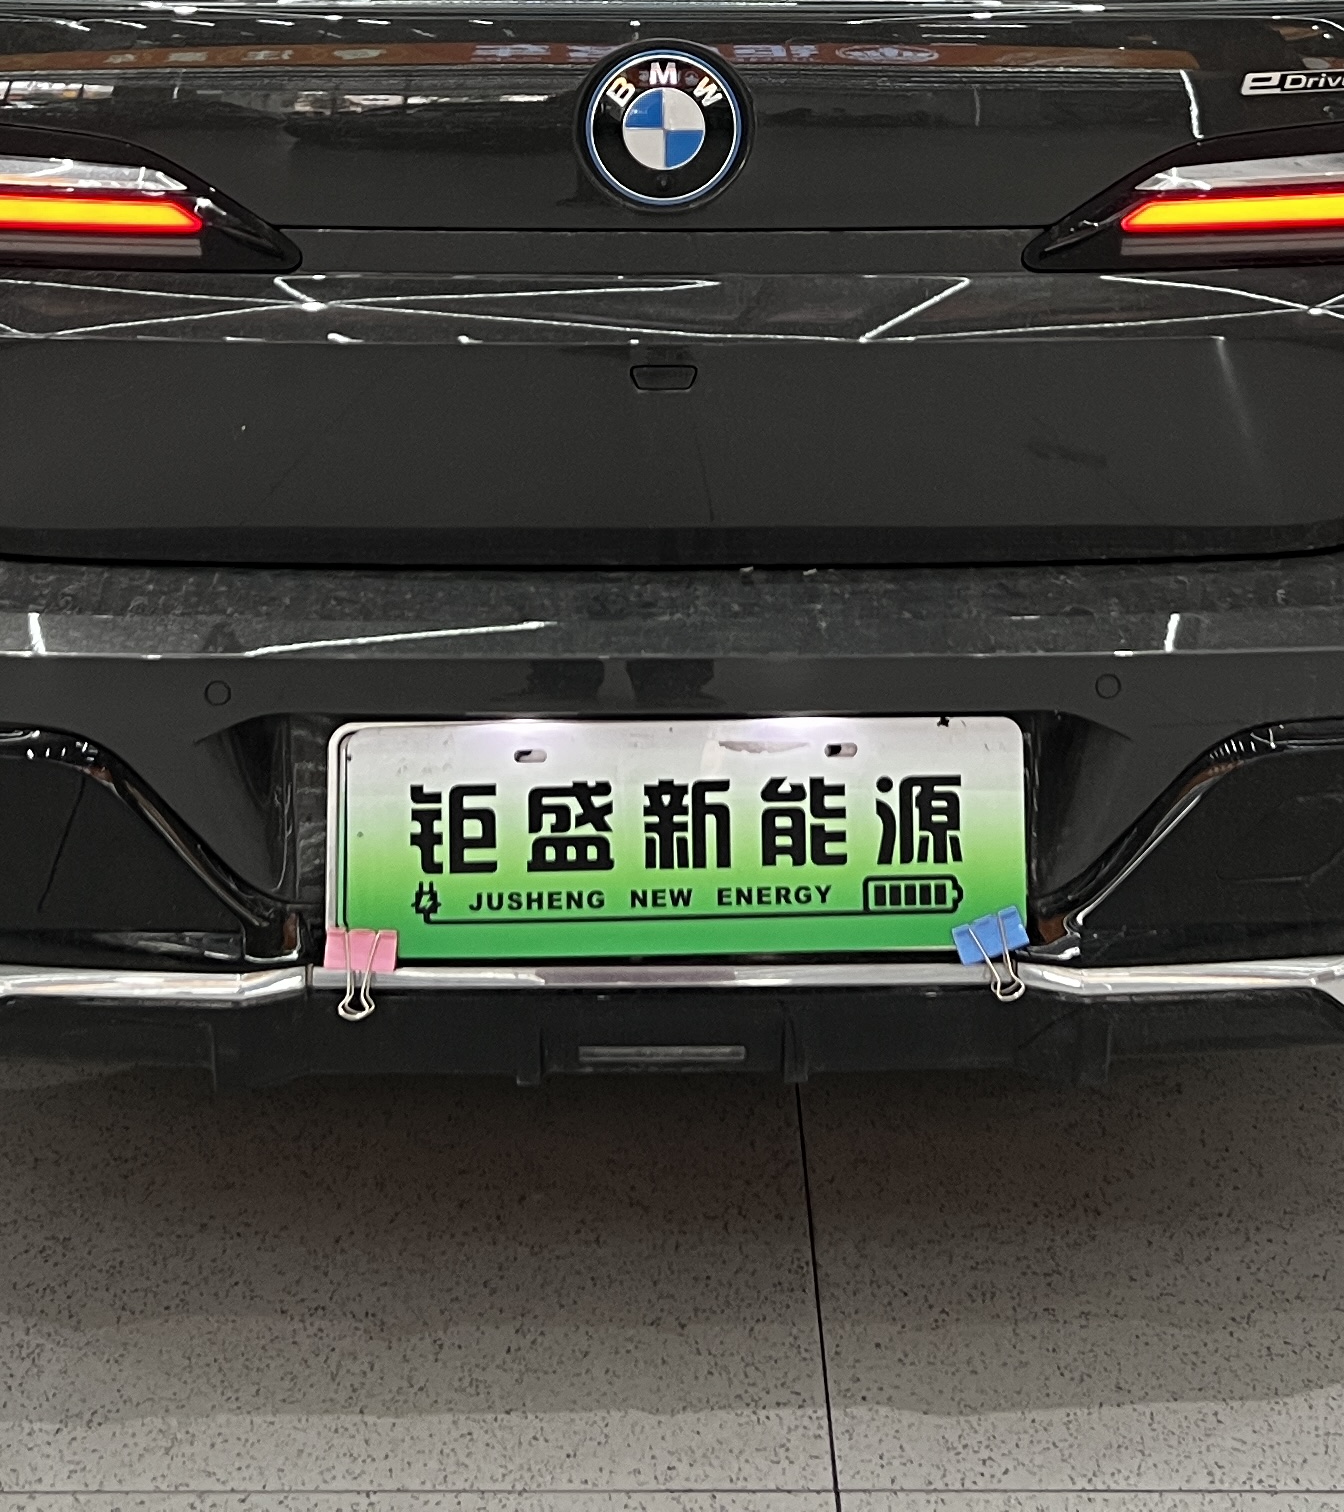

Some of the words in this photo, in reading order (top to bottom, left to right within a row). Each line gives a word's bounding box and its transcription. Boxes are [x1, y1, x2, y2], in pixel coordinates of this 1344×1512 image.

[606, 61, 723, 108] BMW
[409, 774, 963, 874] 钜盛新能源
[468, 890, 606, 911] JUSHENG
[630, 888, 693, 908] NEW
[717, 885, 832, 907] ENERGY
